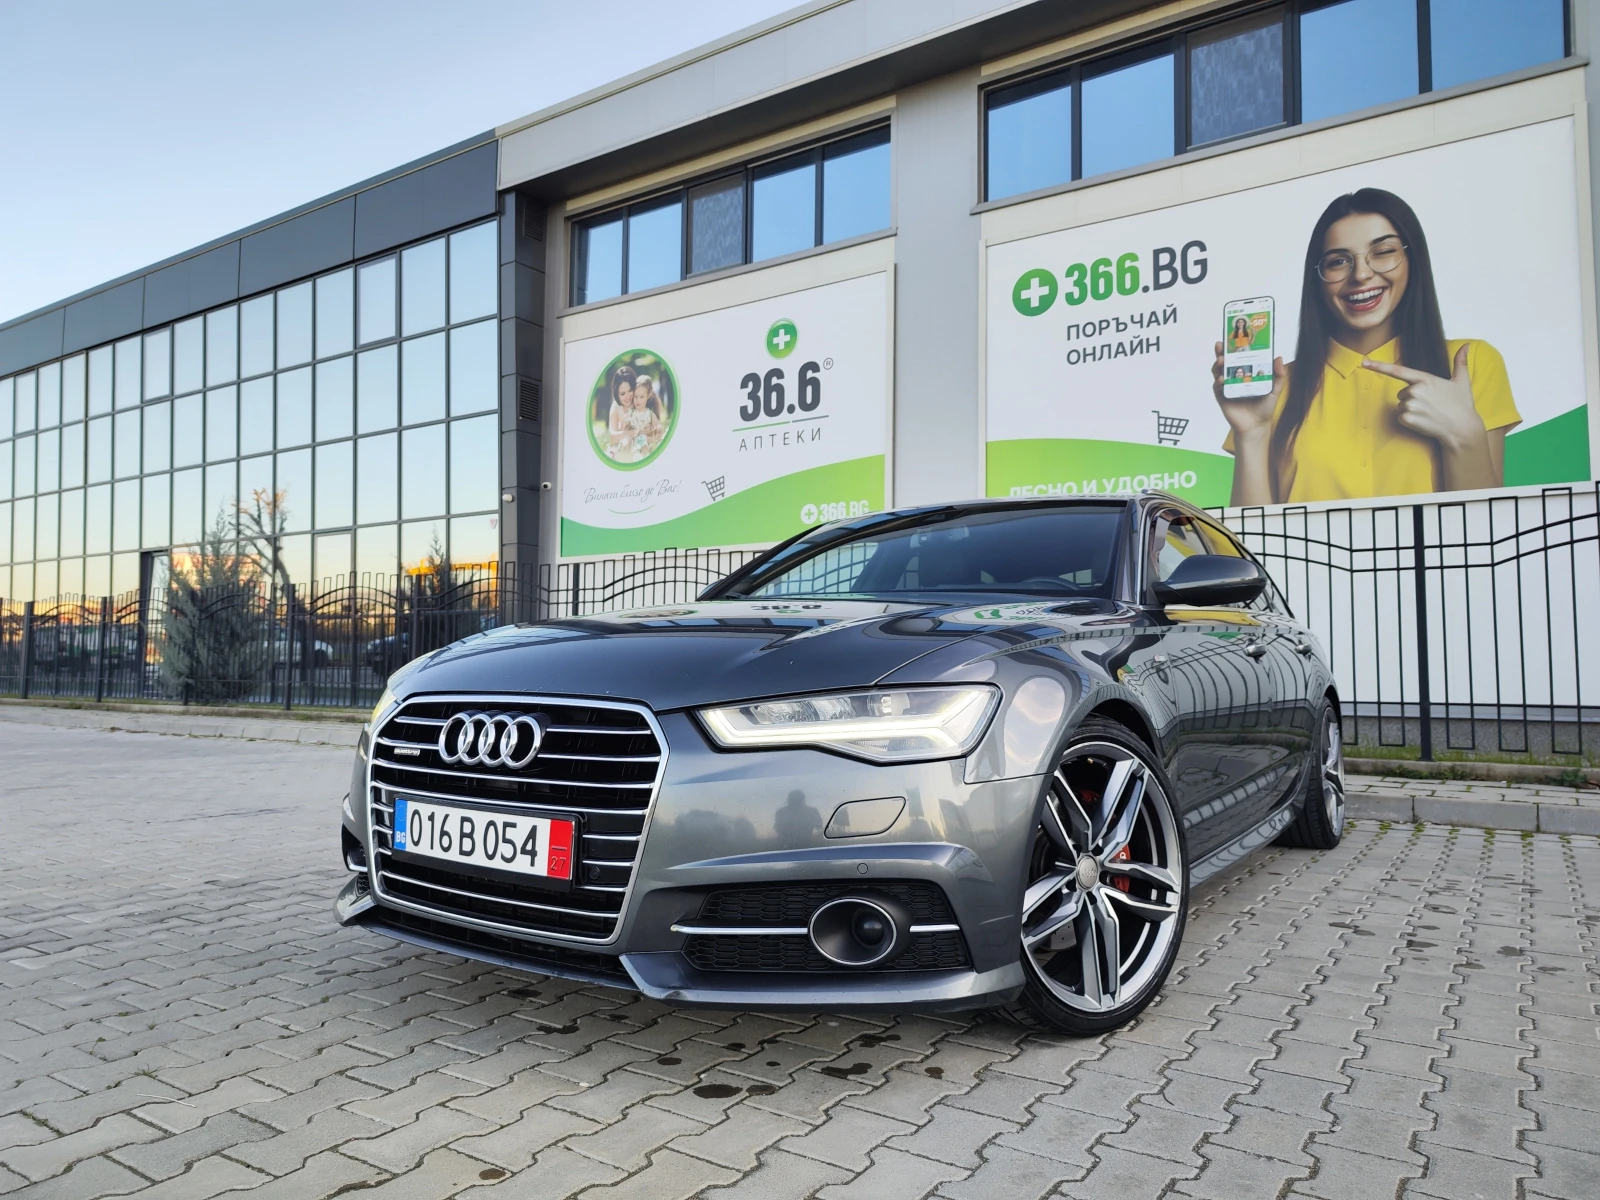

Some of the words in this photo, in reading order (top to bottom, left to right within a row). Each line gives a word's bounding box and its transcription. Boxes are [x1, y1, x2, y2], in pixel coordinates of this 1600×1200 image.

[1064, 240, 1209, 306] 366.BG
[1066, 303, 1179, 341] ПОРЪЧАЙ
[1066, 335, 1161, 365] ОНЛАЙН
[739, 361, 821, 422] 36.6
[738, 427, 822, 452] АПТЕКИ
[1083, 479, 1097, 495] И
[1102, 470, 1197, 494] УДОБНО
[395, 831, 406, 844] BG
[550, 855, 567, 871] 27
